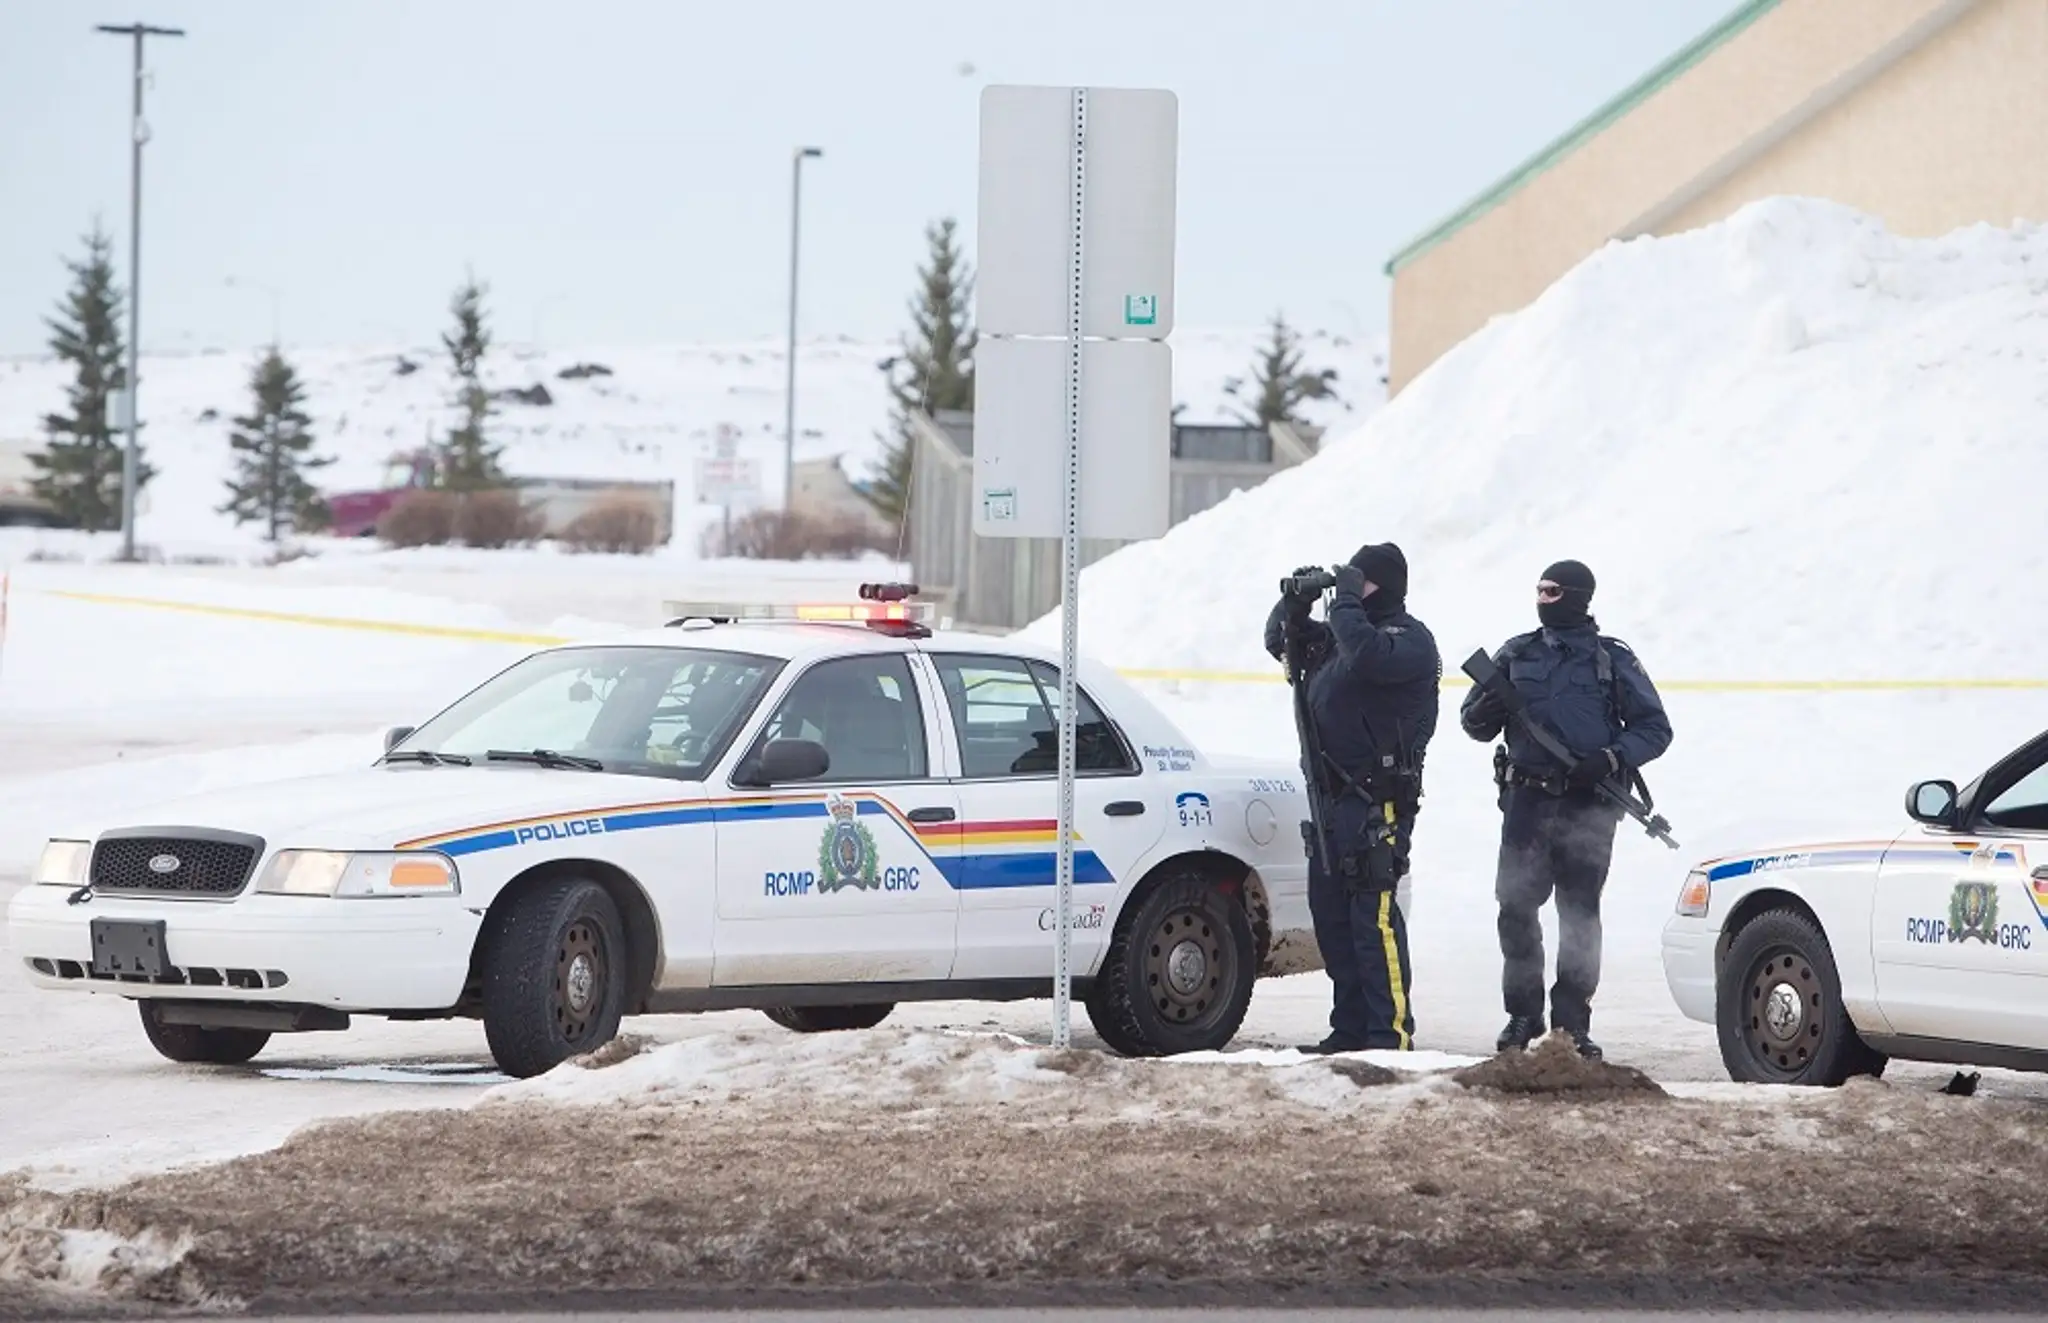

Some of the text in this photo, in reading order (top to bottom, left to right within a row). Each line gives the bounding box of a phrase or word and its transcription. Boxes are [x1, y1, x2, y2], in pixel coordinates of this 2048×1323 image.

[517, 818, 602, 844] POLICE
[1179, 810, 1212, 826] 9-1-1
[765, 866, 920, 896] RCMP GRC
[1038, 907, 1104, 931] Cada
[1907, 917, 2031, 949] RCMP GRC
